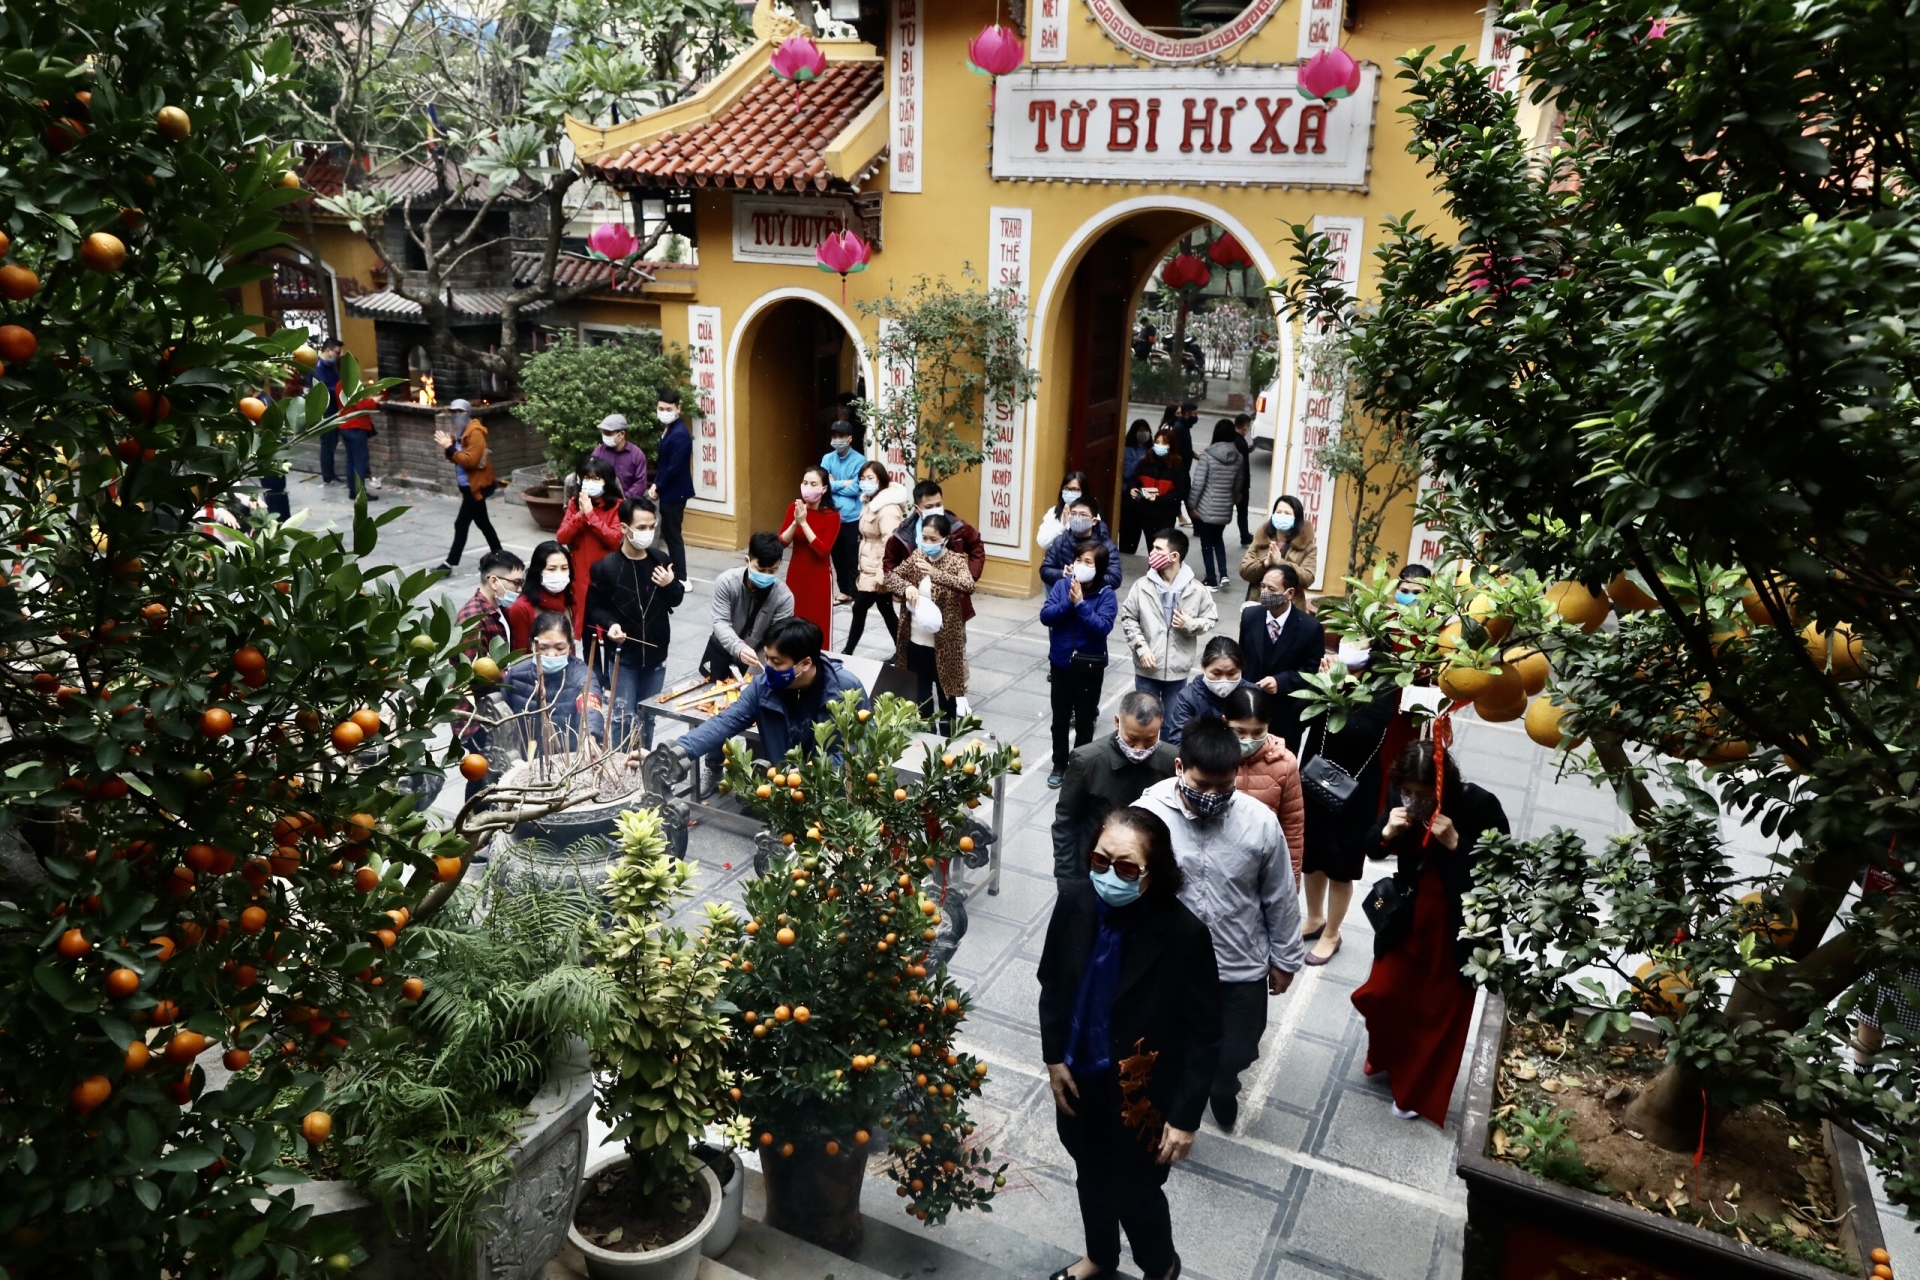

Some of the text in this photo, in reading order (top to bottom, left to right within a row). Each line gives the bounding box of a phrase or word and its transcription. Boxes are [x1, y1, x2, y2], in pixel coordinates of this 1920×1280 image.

[1309, 17, 1330, 42] GIÁC
[901, 50, 913, 73] BI
[1028, 98, 1098, 152] TỪ
